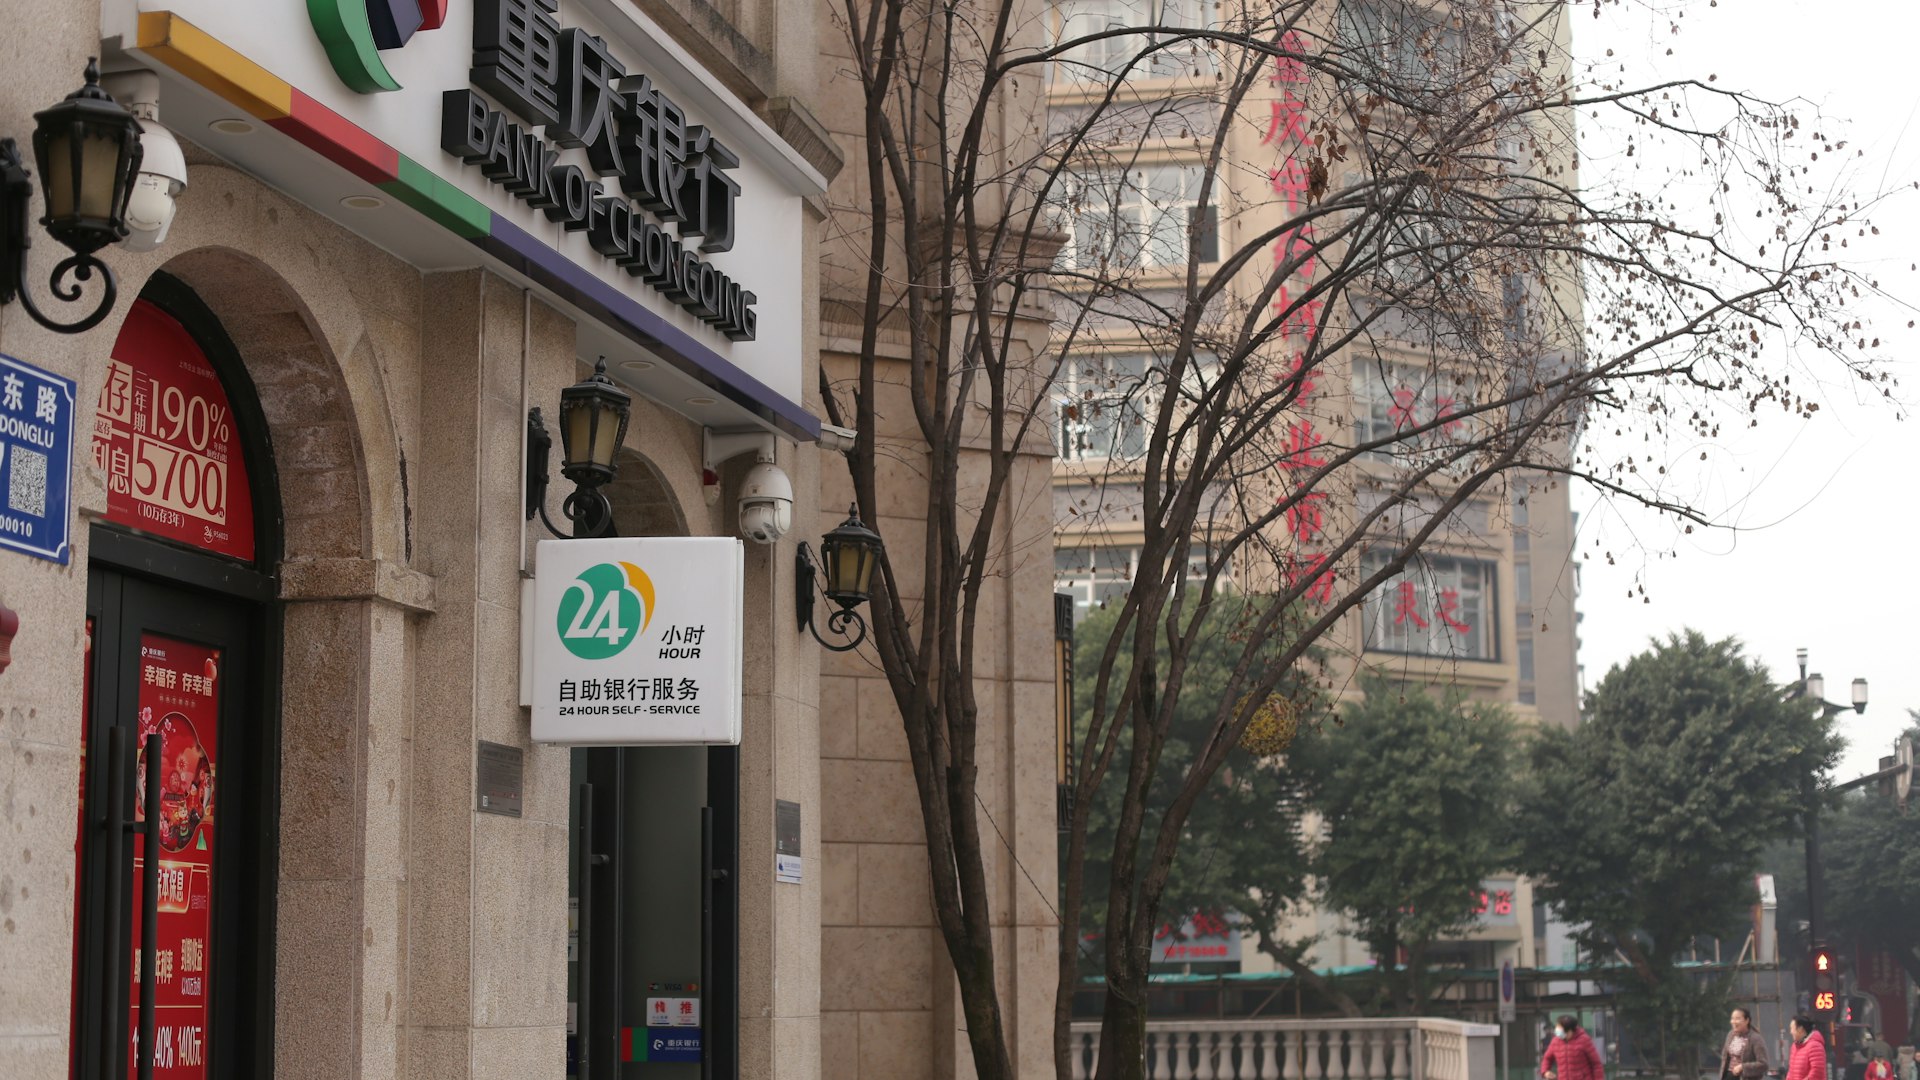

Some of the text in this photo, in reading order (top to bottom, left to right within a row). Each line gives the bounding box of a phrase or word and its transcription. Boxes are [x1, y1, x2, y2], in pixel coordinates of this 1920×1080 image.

[474, 0, 741, 252] 重庆银行
[445, 89, 757, 341] BANK OF CHONGQING
[3, 372, 58, 425] 东路
[97, 362, 131, 417] 存
[133, 369, 148, 433] 三年期
[0, 414, 54, 449] DONGLU
[149, 378, 229, 451] 1.90%
[134, 441, 222, 515] 5700
[137, 502, 186, 528] (10万存3年)
[564, 579, 628, 645] 24
[661, 624, 705, 645] 小时
[658, 648, 701, 659] HOUR
[144, 664, 213, 697] 幸福存 存幸福
[559, 677, 699, 702] 自助银行服务
[559, 707, 575, 716] 24
[577, 706, 609, 715] HOUR
[612, 705, 642, 715] SELF
[649, 705, 701, 714] SERVICE
[155, 949, 174, 985] 年利率
[680, 1000, 692, 1015] 推
[1815, 992, 1835, 1010] 65
[132, 1025, 202, 1069] 1 .40% 1400元
